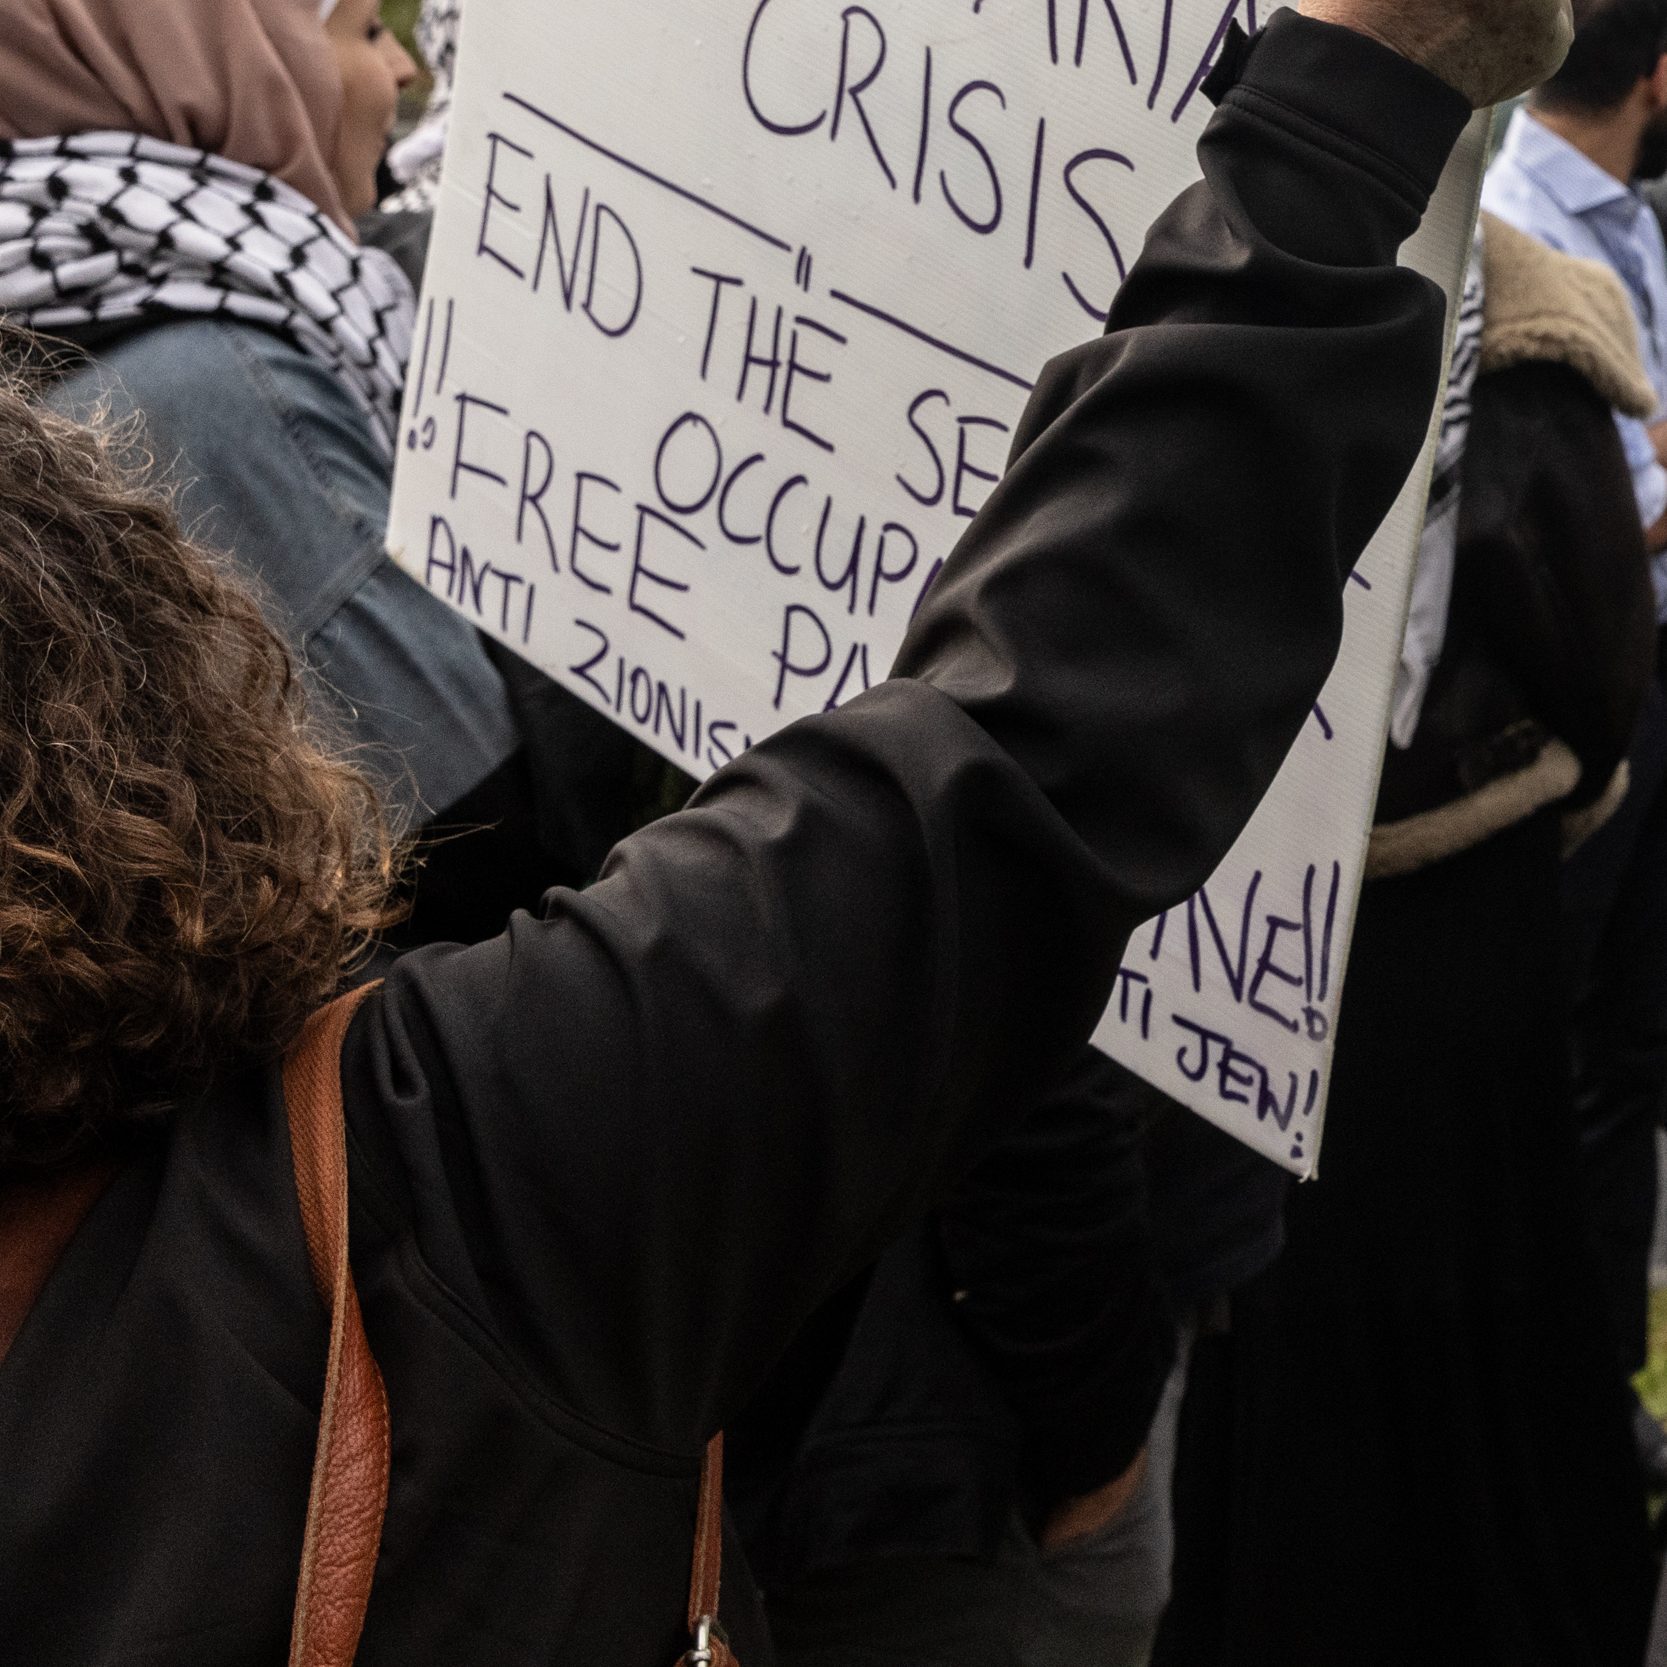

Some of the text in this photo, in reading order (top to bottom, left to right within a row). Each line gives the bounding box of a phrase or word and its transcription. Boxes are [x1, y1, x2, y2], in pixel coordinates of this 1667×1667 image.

[477, 132, 643, 338] END
[690, 266, 848, 453] THE
[425, 514, 536, 645] ANTI
[451, 391, 707, 641] FREE
